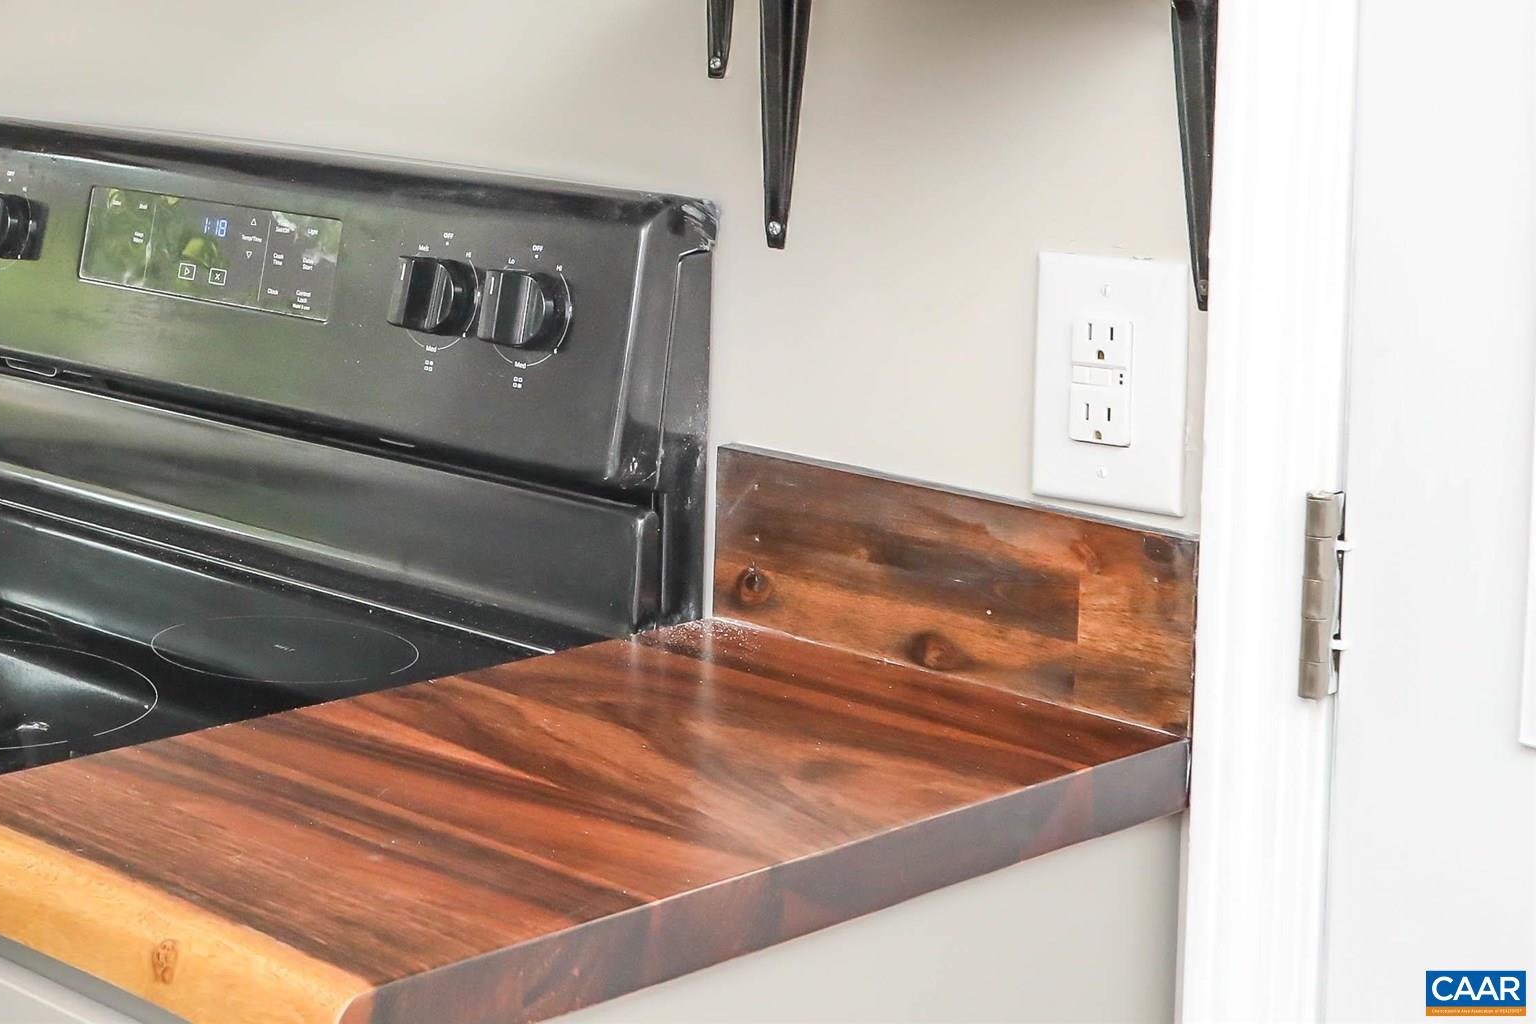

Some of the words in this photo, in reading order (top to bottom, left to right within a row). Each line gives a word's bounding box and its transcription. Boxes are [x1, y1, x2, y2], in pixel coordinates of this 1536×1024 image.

[204, 217, 228, 237] 1:18
[426, 345, 437, 353] Med
[515, 362, 527, 370] Med
